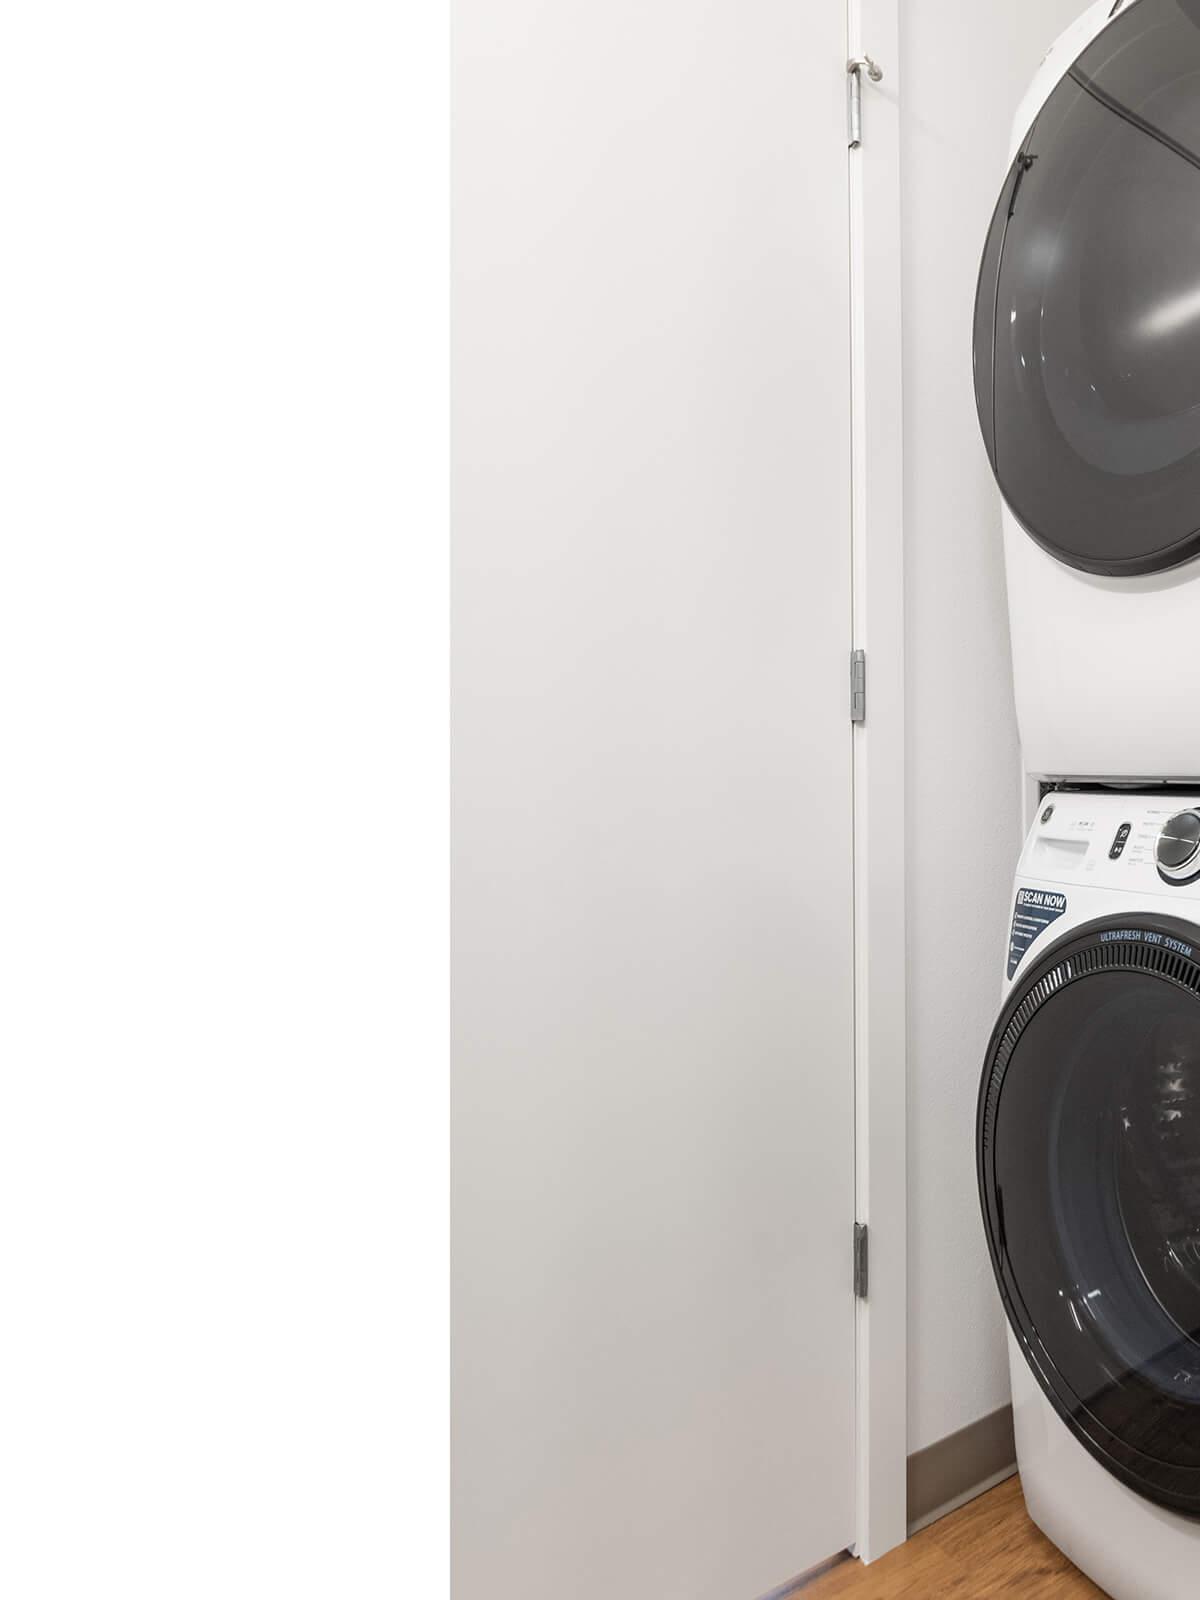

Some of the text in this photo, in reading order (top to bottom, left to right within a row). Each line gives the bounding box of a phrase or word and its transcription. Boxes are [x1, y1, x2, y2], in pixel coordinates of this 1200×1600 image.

[1023, 890, 1044, 905] SCAN
[1044, 893, 1066, 909] NOW
[1100, 929, 1193, 958] ULTRAFRESH VENT SYSTEM
